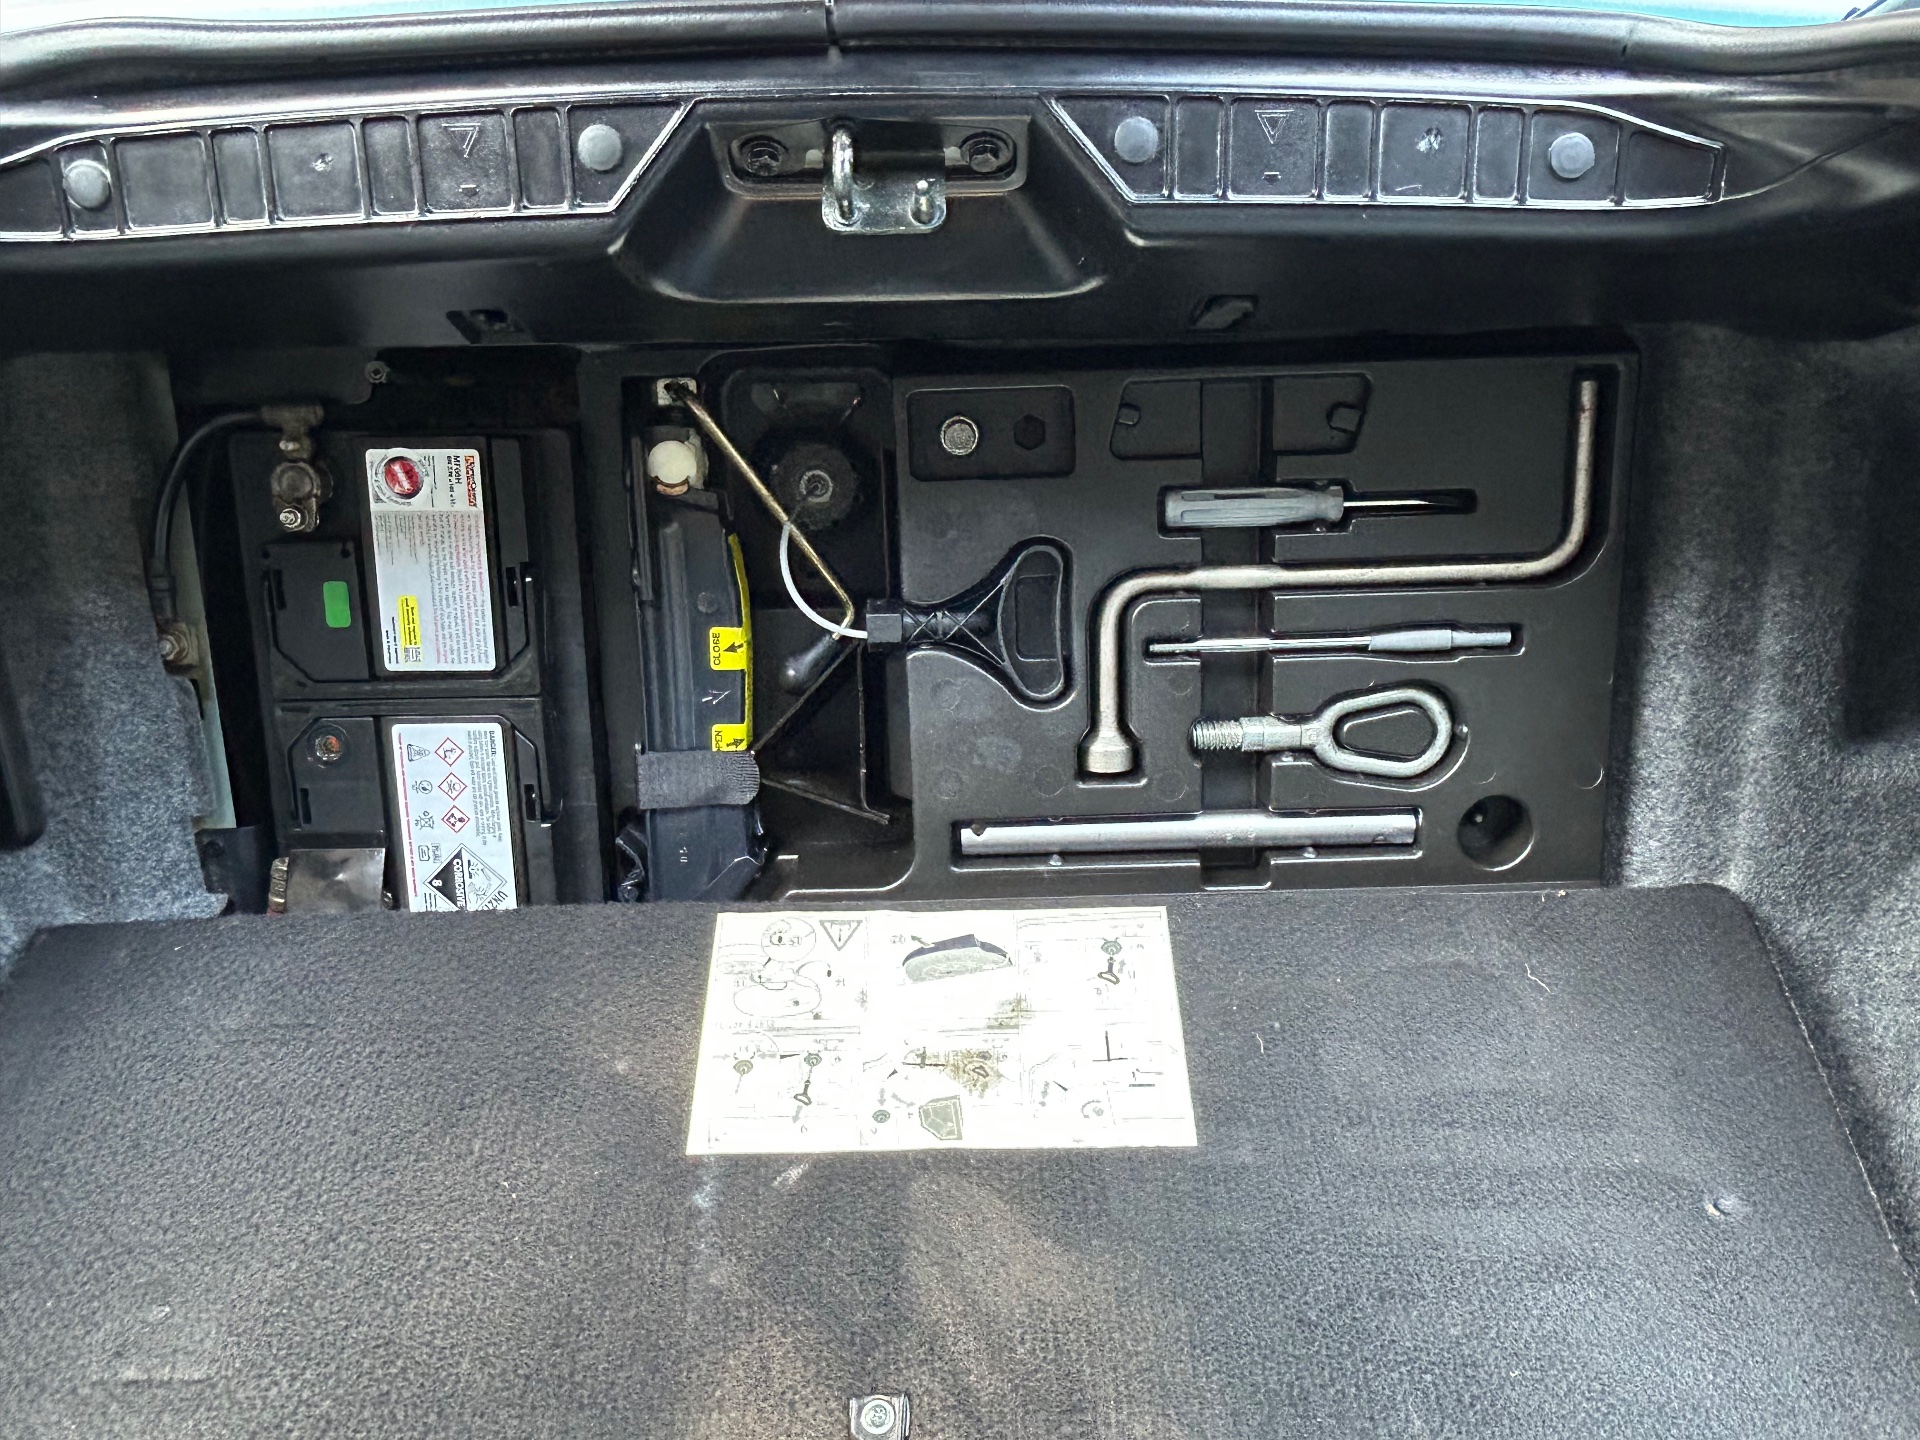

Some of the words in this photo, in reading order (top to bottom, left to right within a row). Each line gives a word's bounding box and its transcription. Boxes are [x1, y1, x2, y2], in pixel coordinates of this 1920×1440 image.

[712, 632, 721, 666] CLOSE
[431, 879, 443, 887] 8
[453, 858, 466, 907] CORROSIVE
